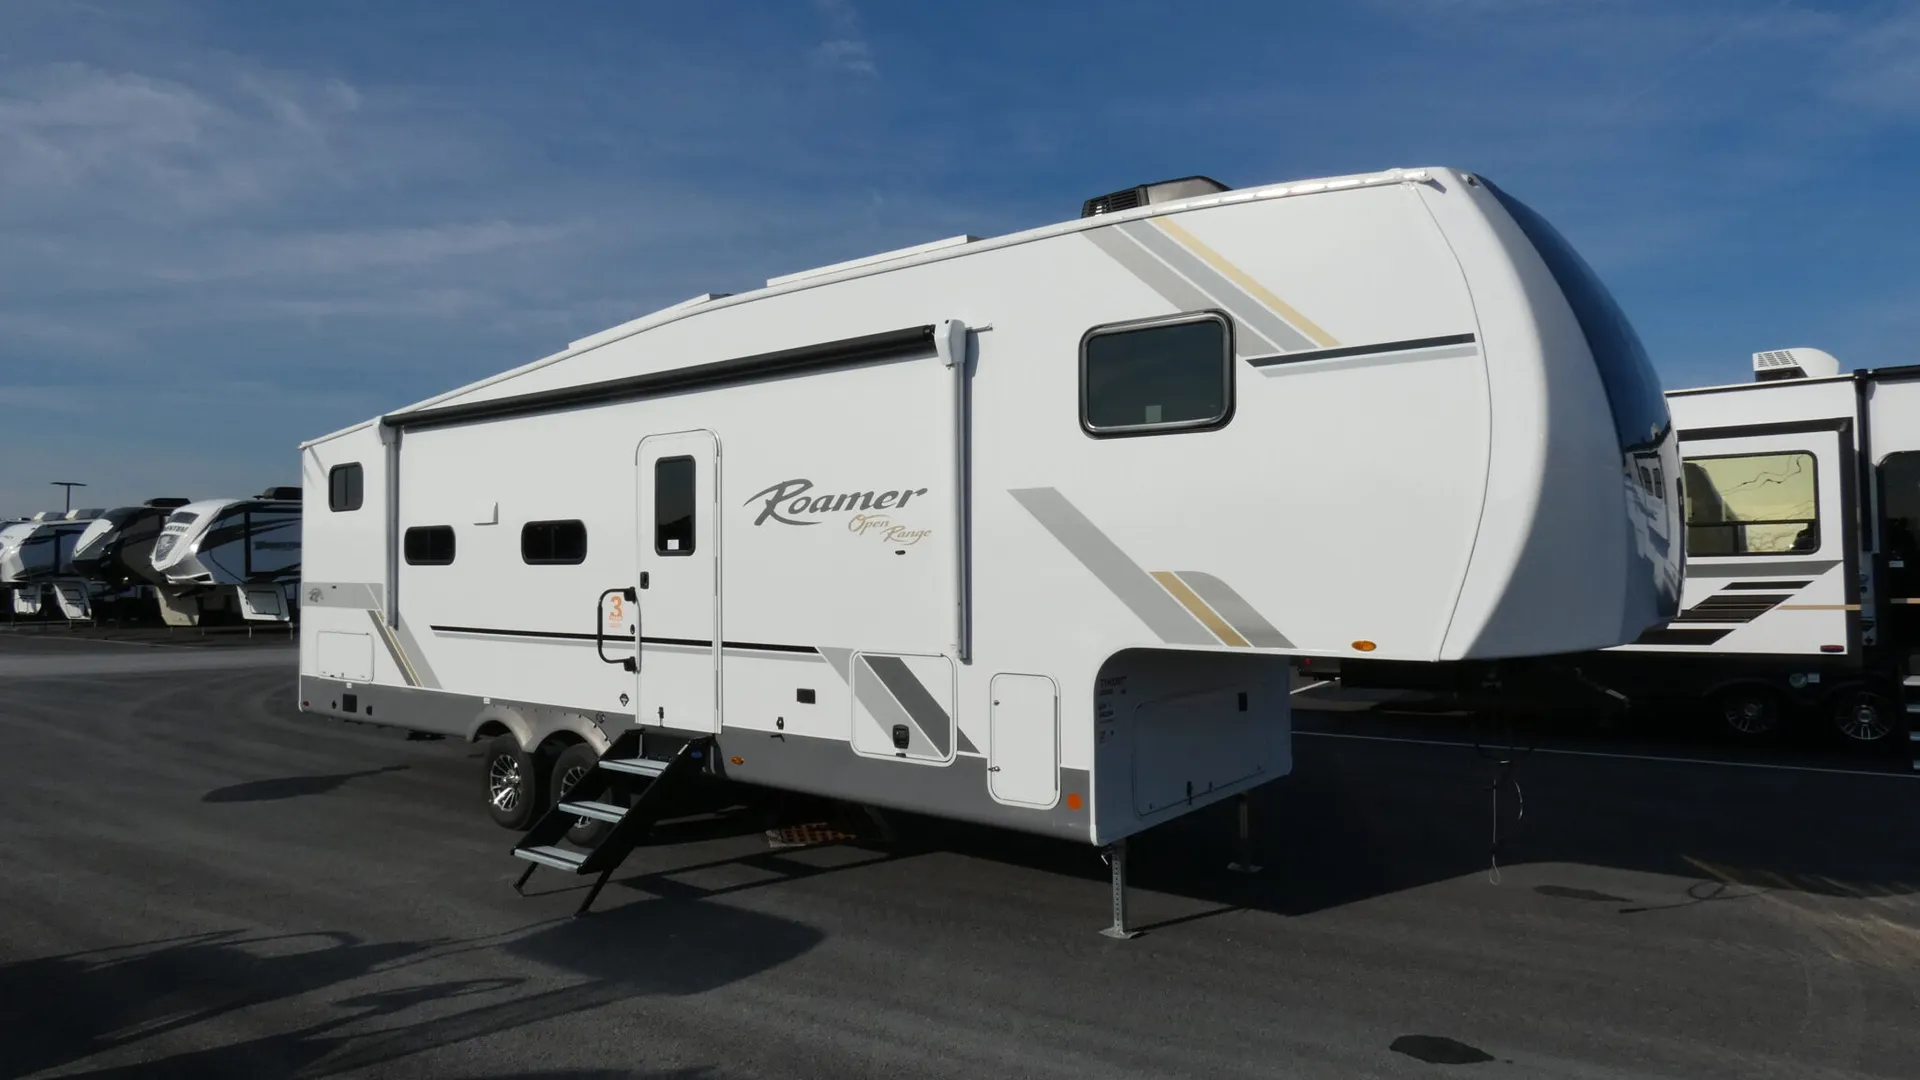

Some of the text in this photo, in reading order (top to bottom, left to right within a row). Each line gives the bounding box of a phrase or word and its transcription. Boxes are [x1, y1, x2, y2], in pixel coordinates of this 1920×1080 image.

[742, 478, 928, 526] Roamer
[848, 514, 893, 535] Open
[880, 525, 932, 545] Range
[610, 596, 622, 616] 3
